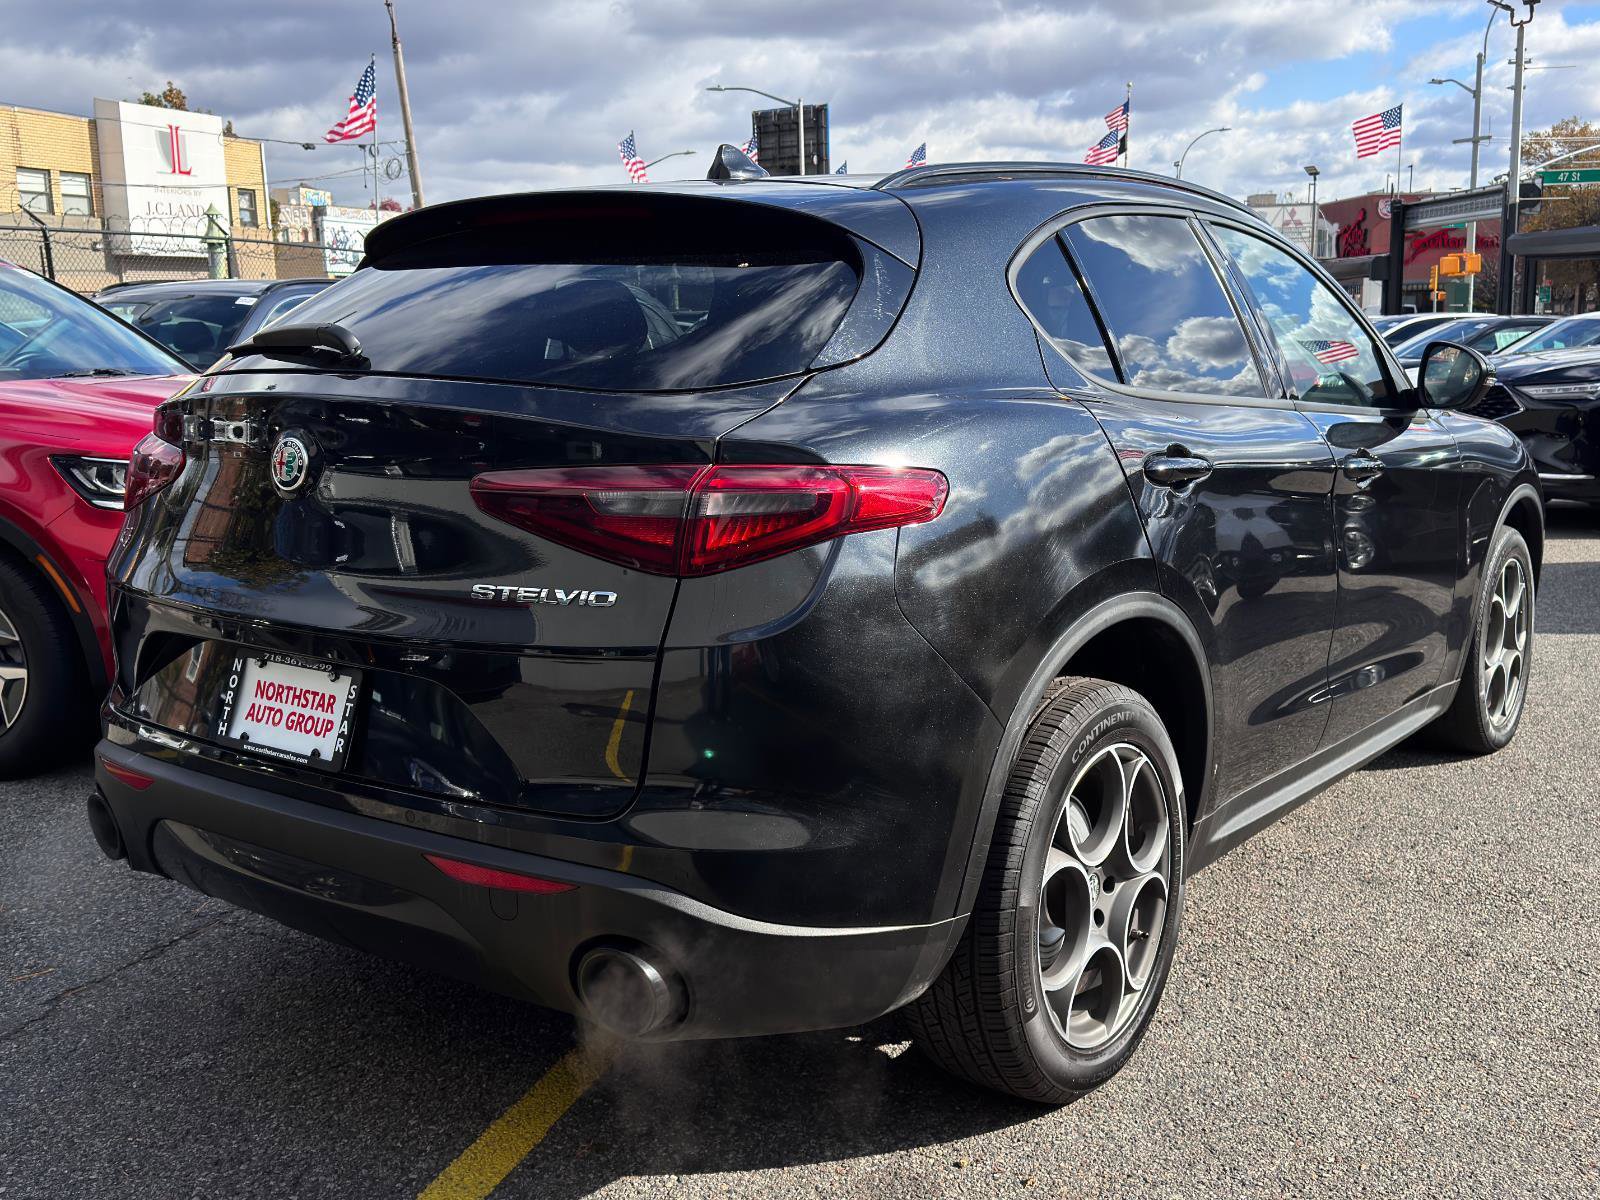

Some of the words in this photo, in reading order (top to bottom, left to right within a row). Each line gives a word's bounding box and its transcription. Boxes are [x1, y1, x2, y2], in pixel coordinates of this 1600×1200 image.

[1558, 172, 1569, 181] 47
[1571, 172, 1580, 181] St
[470, 584, 618, 607] STELVIO
[254, 679, 337, 715] NORTHSTAR
[245, 702, 283, 728] AUTO
[285, 711, 334, 739] GROUP
[1071, 710, 1142, 764] CONTINENTA
